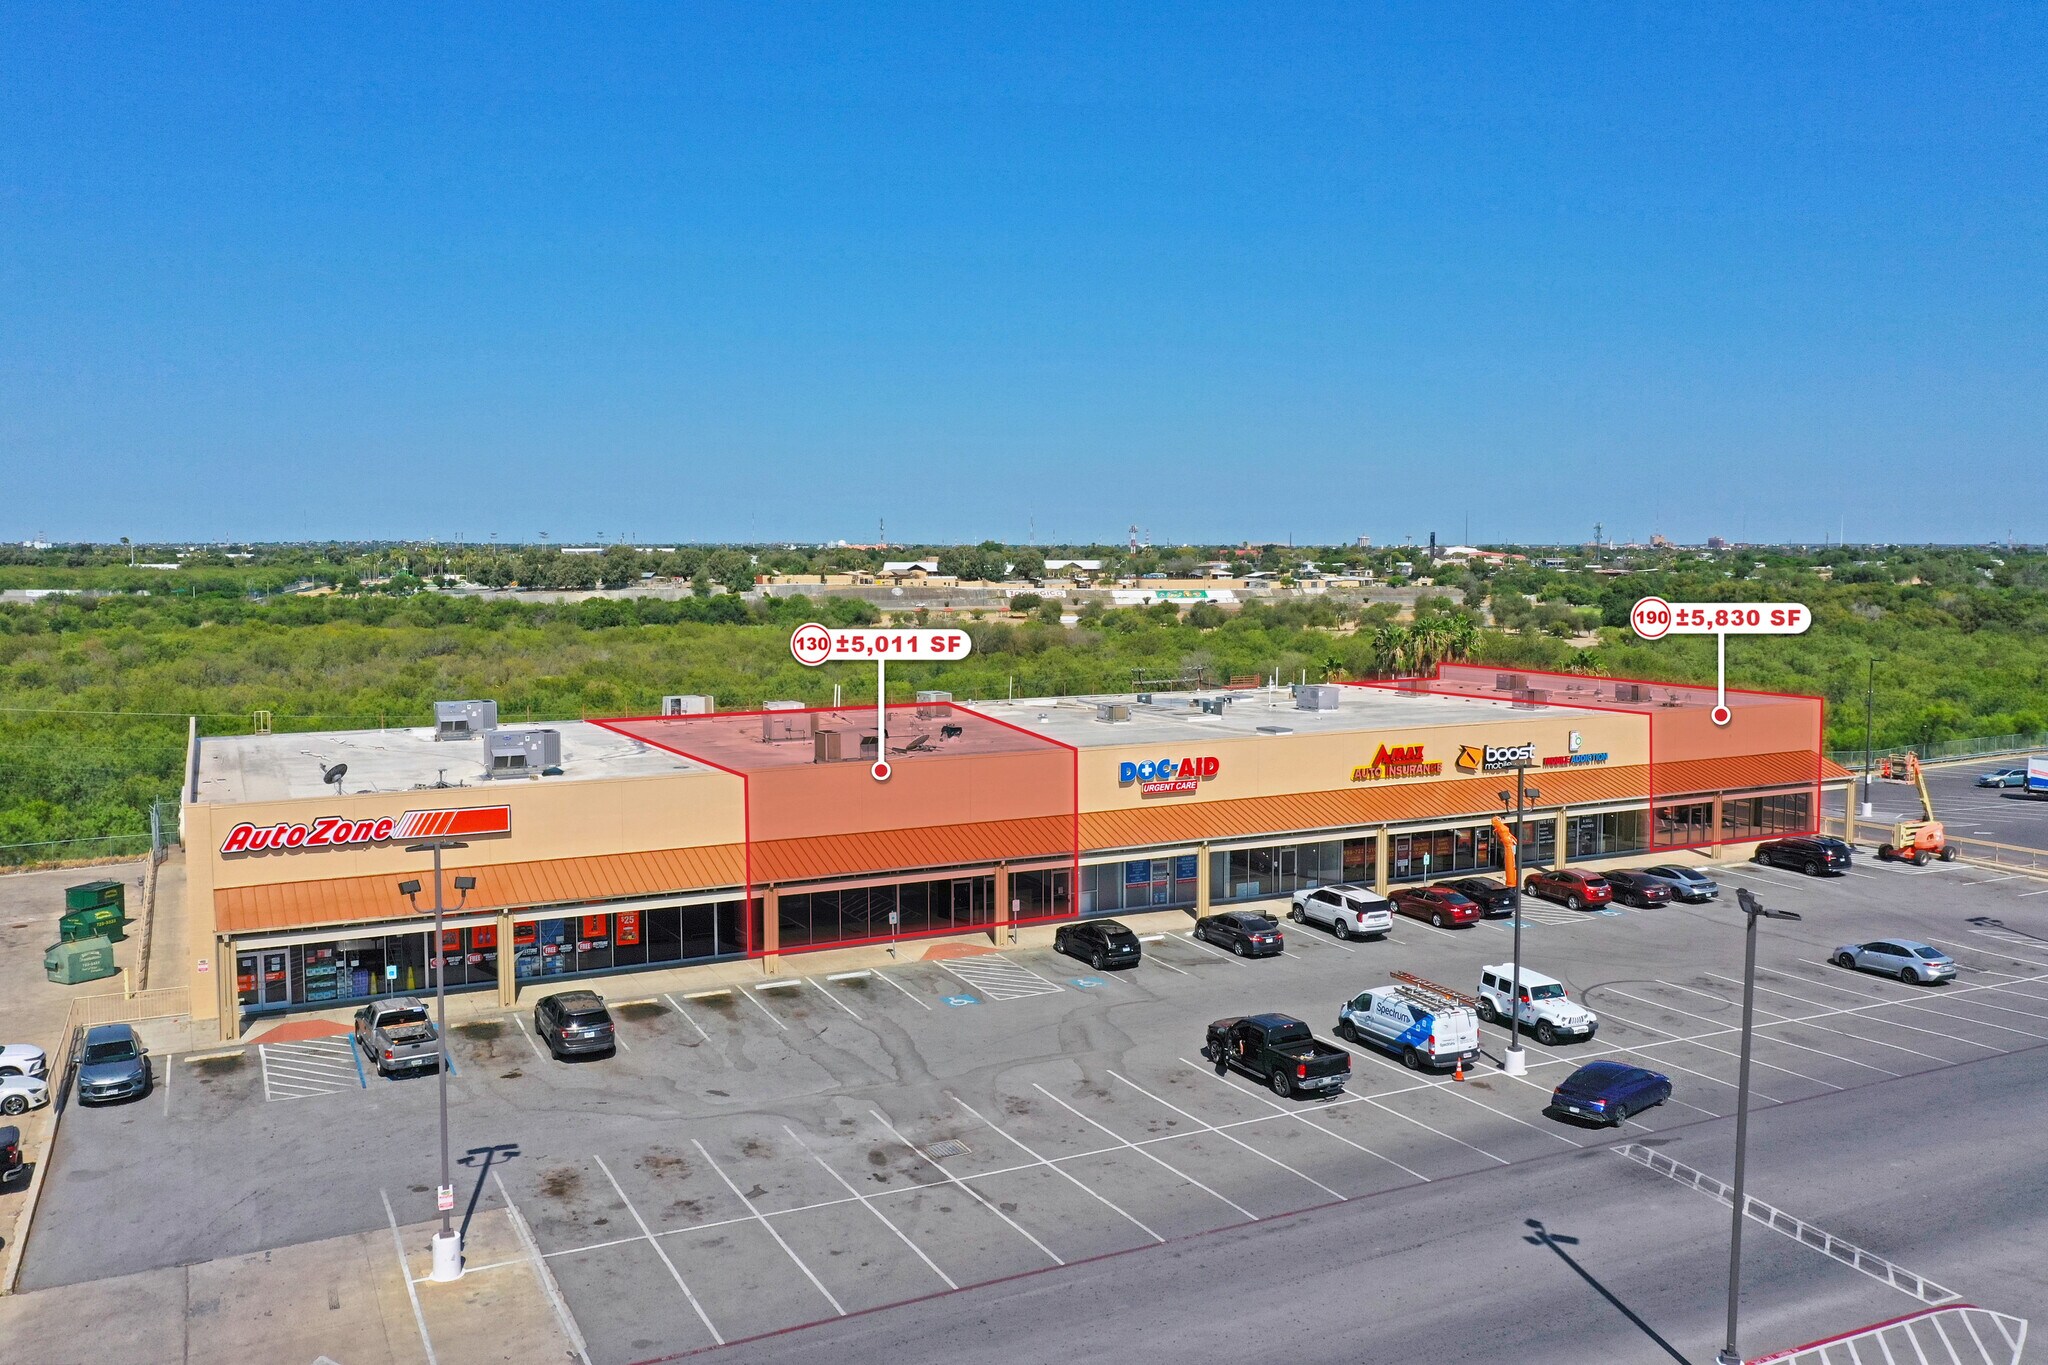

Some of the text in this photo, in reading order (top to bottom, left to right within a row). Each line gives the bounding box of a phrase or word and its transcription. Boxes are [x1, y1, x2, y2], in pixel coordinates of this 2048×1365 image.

[1486, 744, 1536, 762] boost
[1571, 752, 1609, 763] ADDICTION
[1120, 757, 1220, 782] DOC-AID
[1354, 762, 1443, 779] AUTO INSURANCE
[1143, 781, 1197, 793] URGENT CARE
[221, 816, 396, 853] AutoZone
[1376, 1002, 1411, 1023] Spectrum
